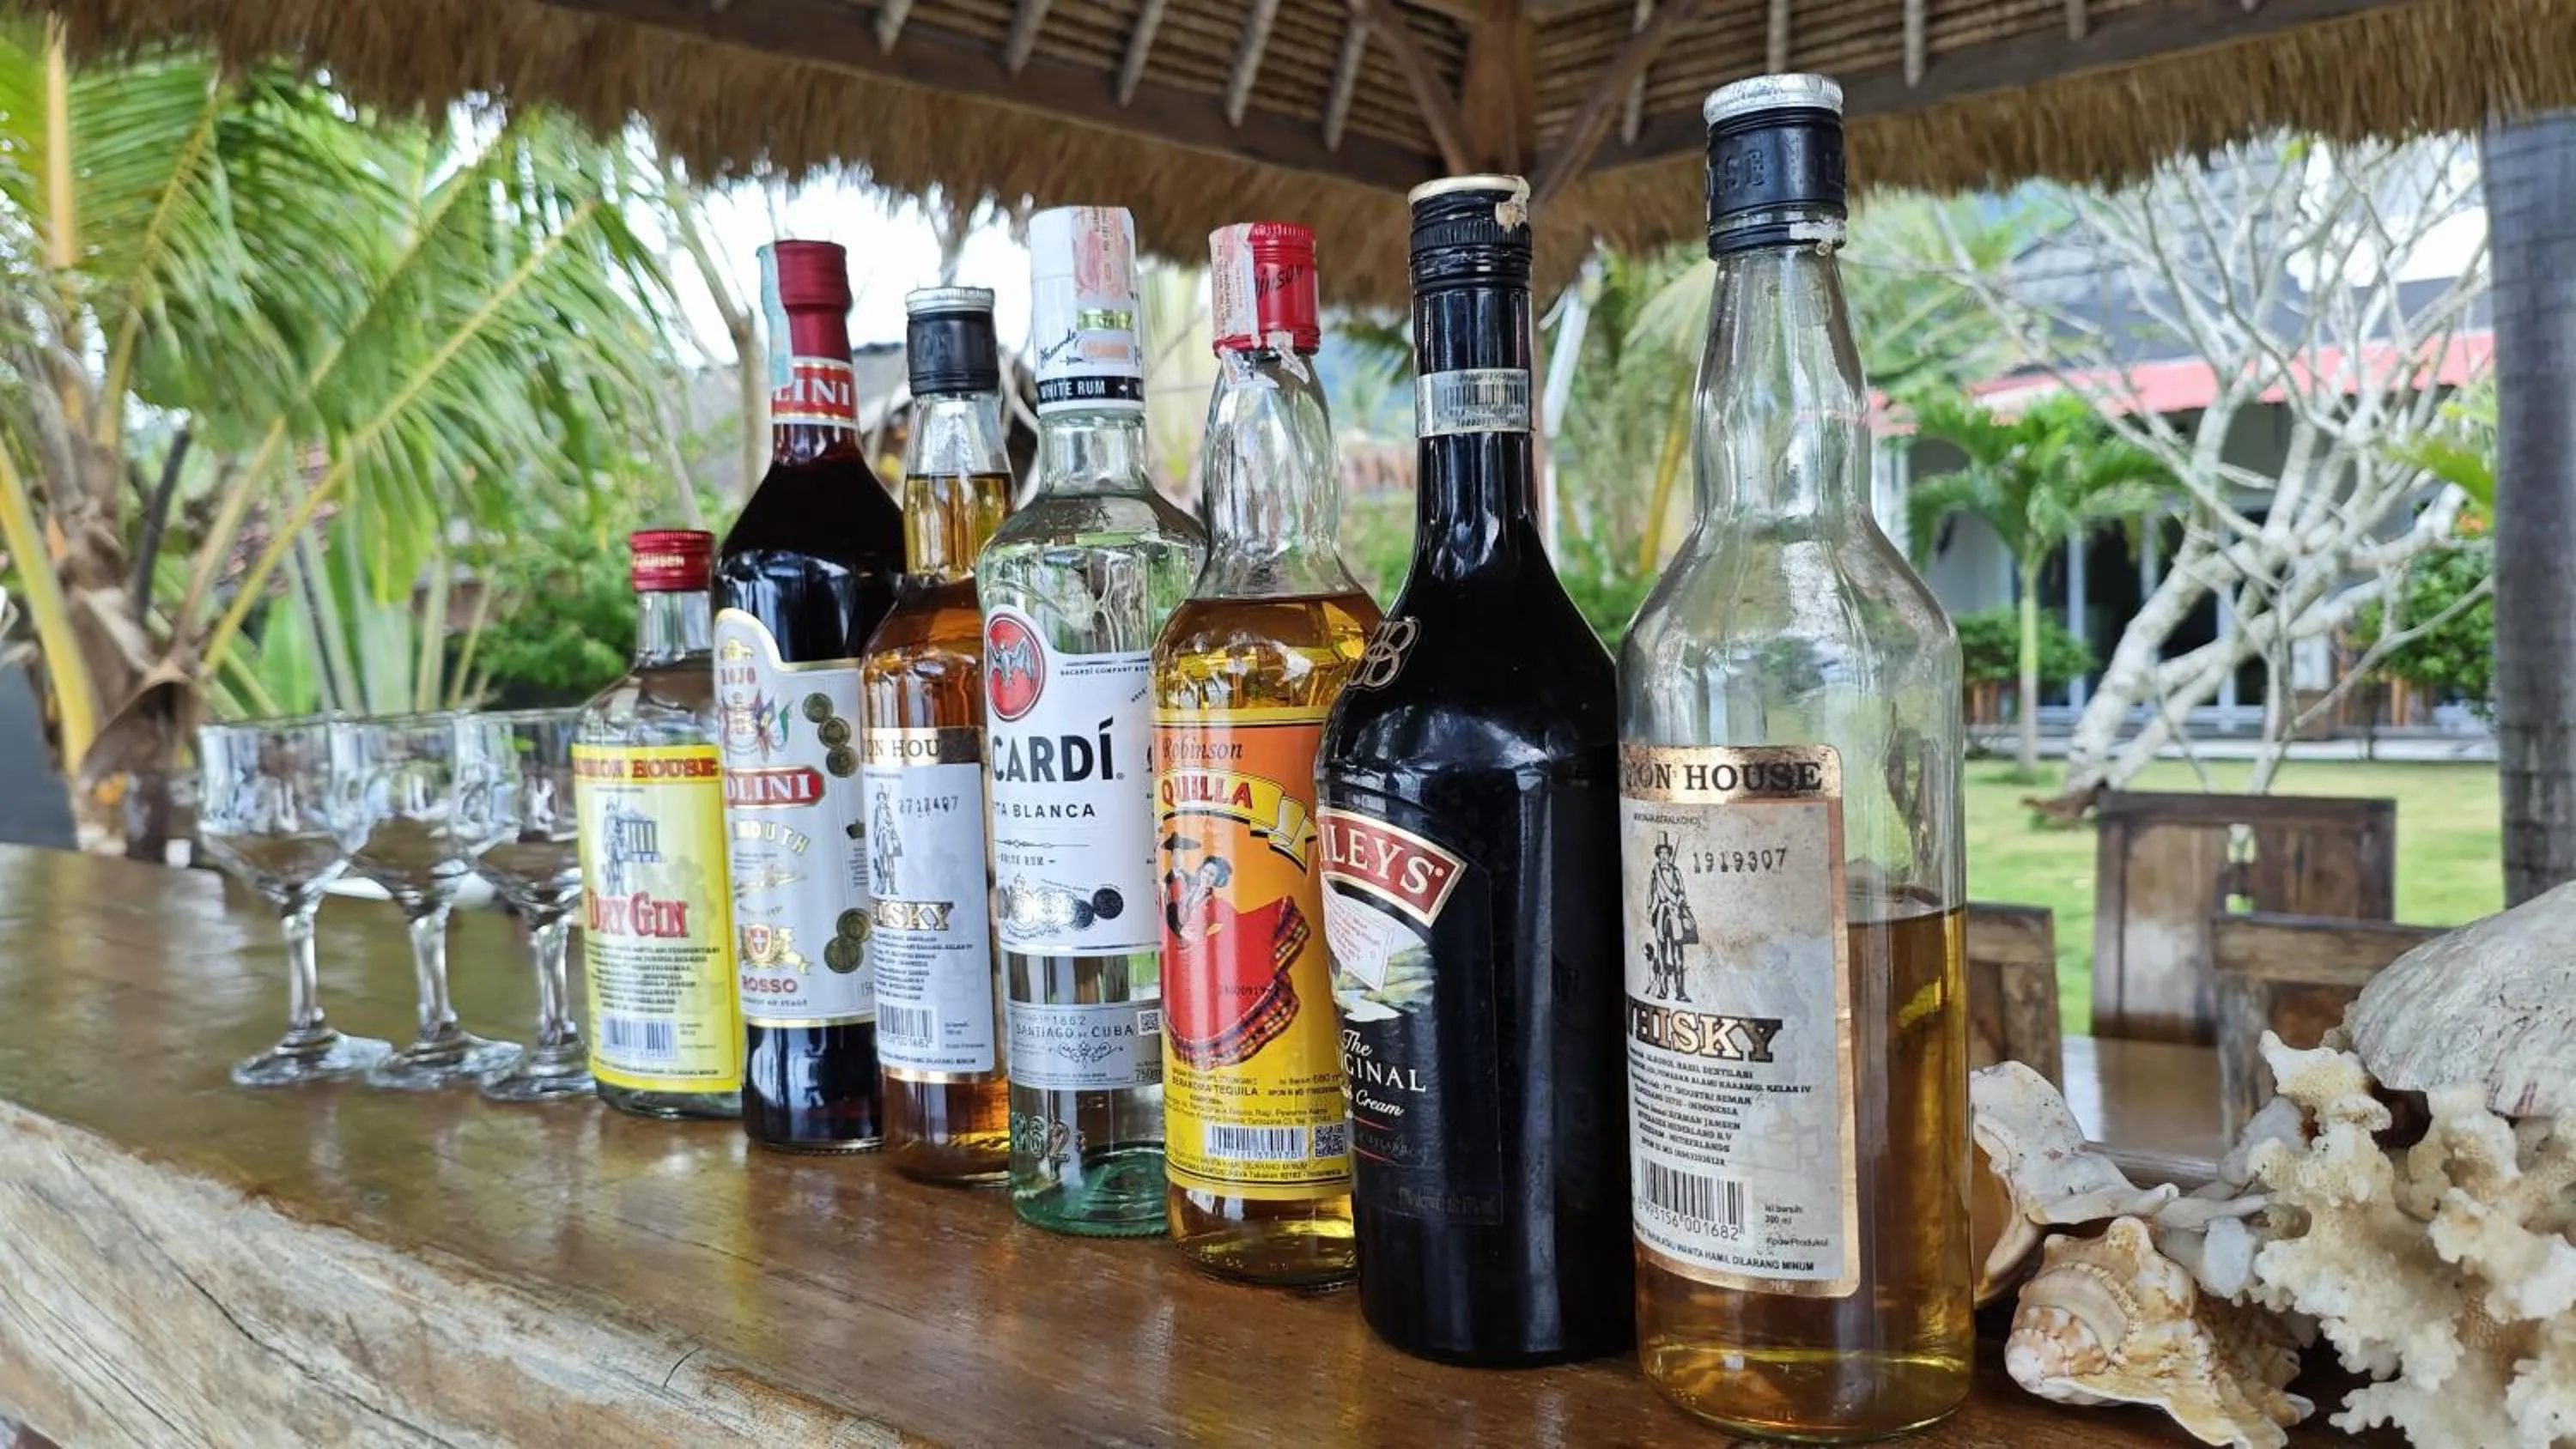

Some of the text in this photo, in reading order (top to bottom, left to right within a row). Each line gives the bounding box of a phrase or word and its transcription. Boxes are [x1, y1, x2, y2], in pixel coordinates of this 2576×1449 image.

[1041, 380, 1106, 402] WHITE RUM
[893, 739, 941, 757] HOU
[992, 715, 1115, 783] CARDÍ
[1163, 736, 1243, 762] Robinson
[1625, 762, 1823, 791] ION HOUSE
[1013, 803, 1096, 818] BLANCA
[732, 820, 811, 856] OUTH
[629, 891, 690, 937] GIN
[1017, 1022, 1074, 1038] SANTIAGO
[1091, 1024, 1134, 1038] CUBA
[1342, 1029, 1373, 1057] The
[1214, 1084, 1258, 1095] TEQUILA
[1356, 1089, 1405, 1117] Cream
[1685, 1216, 1739, 1241] 001682
[1733, 1256, 1780, 1270] DILARANG
[1782, 1261, 1814, 1271] MINUM
